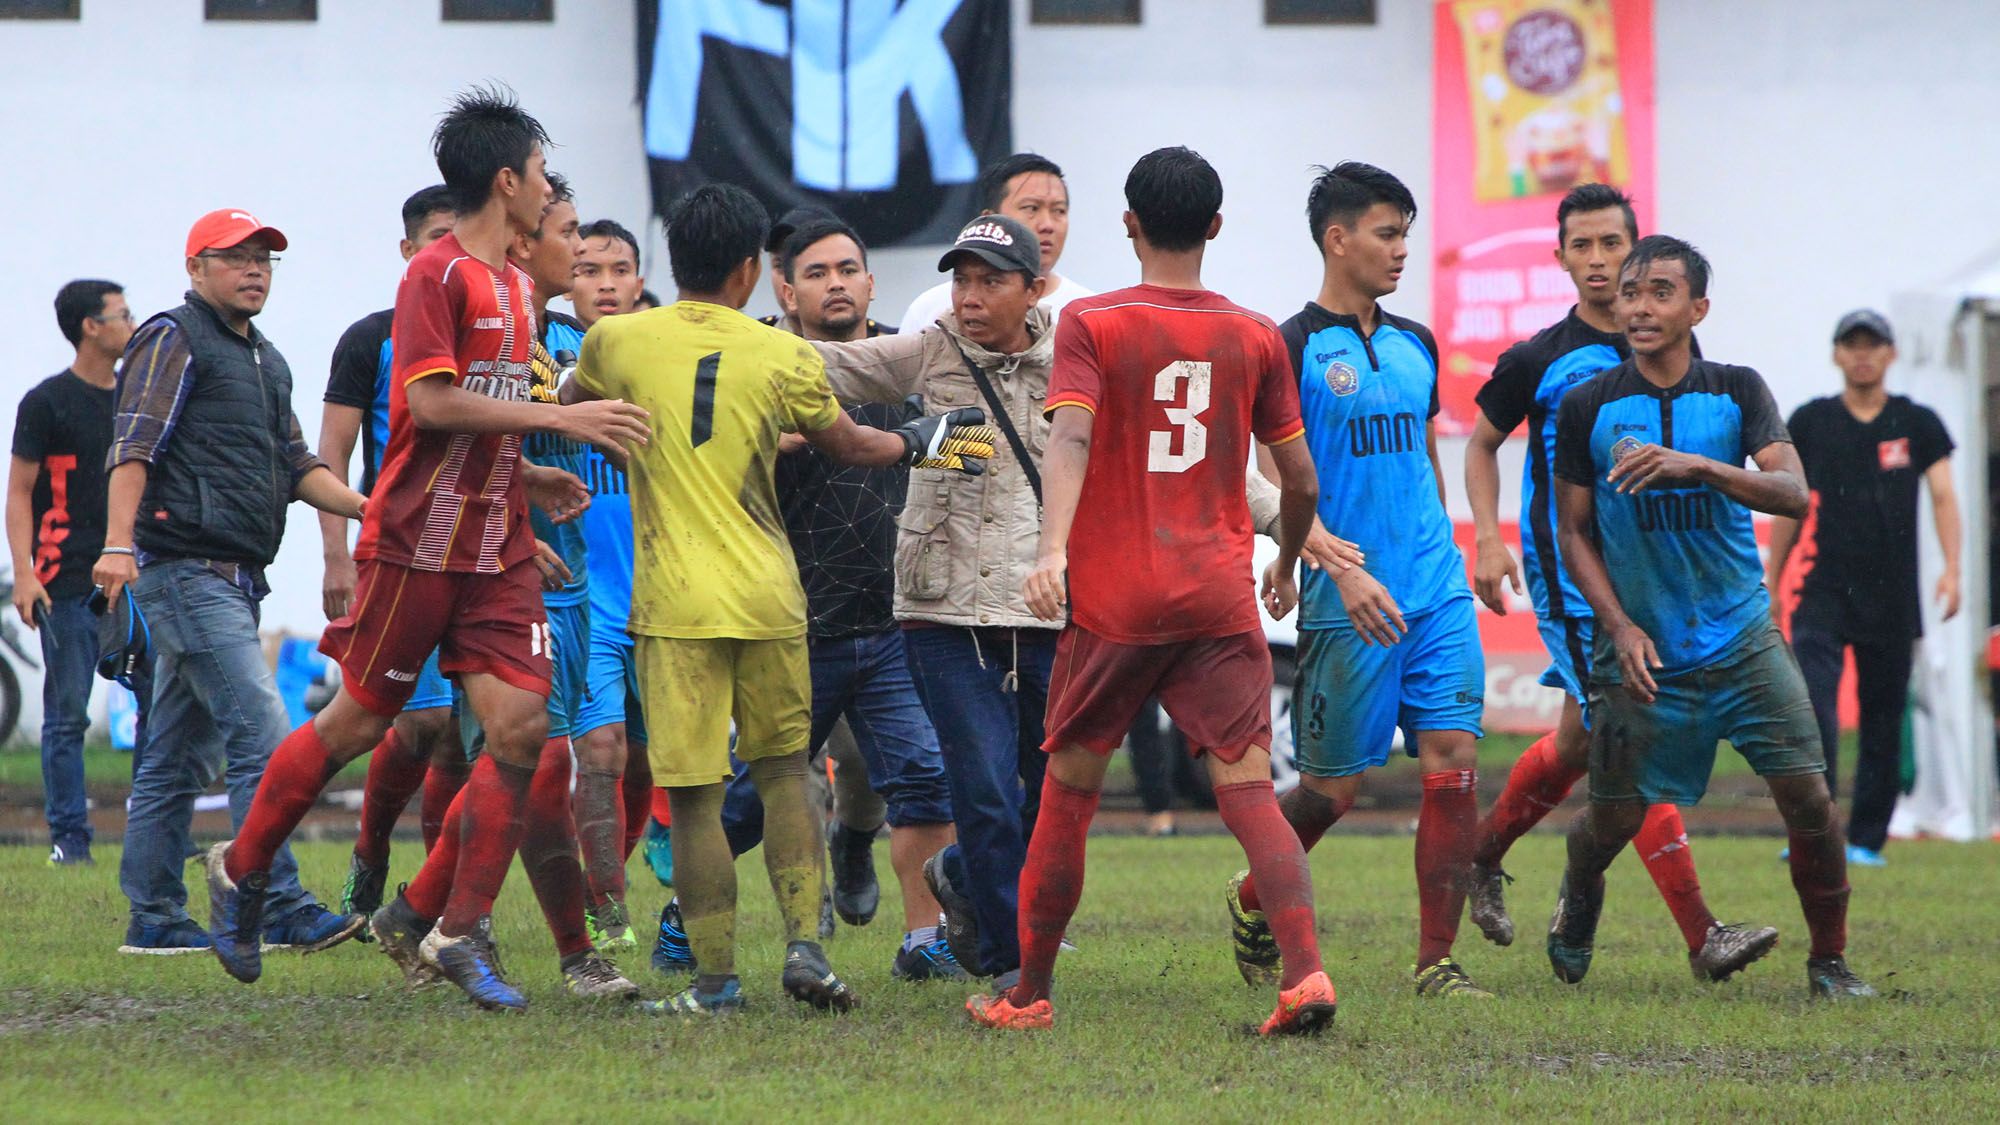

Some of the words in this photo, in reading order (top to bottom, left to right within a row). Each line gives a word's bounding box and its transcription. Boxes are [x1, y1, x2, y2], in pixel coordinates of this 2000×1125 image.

[691, 351, 722, 449] 1
[1147, 360, 1212, 473] 3
[1348, 411, 1418, 458] UMM
[1634, 491, 1713, 532] UMM
[1308, 691, 1328, 741] 8
